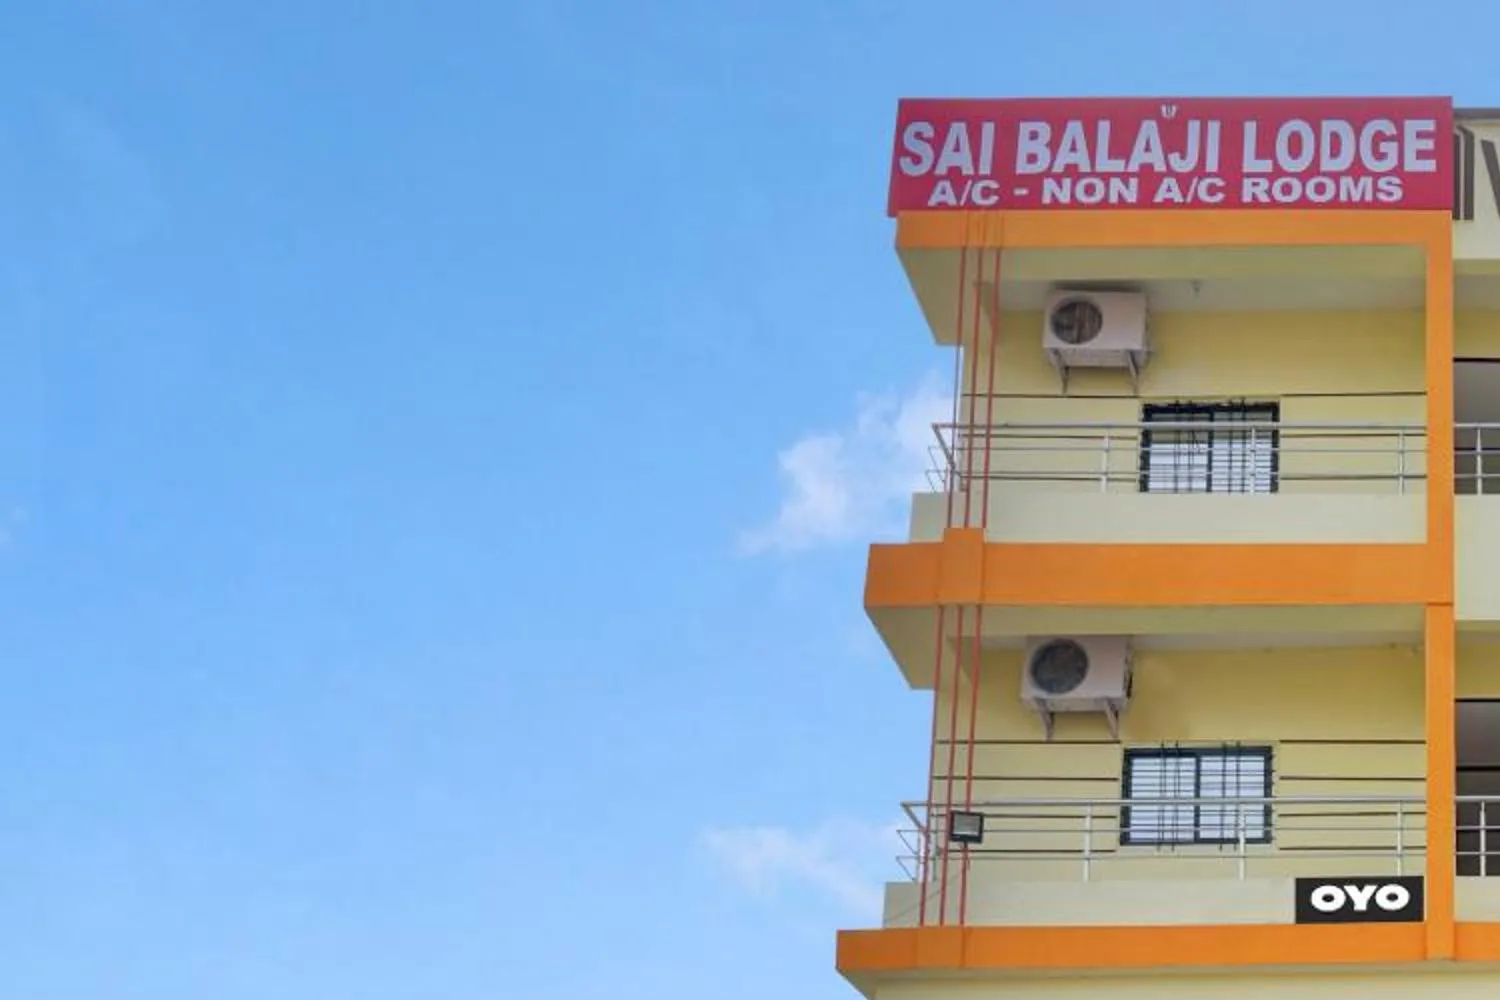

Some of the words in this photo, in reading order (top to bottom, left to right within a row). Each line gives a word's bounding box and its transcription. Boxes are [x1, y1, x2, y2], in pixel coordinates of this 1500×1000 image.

[899, 120, 994, 175] SAI
[1015, 118, 1221, 174] BALAJI
[1243, 119, 1437, 173] LODGE
[927, 179, 999, 207] A/C
[1041, 177, 1139, 204] NON
[1152, 176, 1224, 204] A/C
[1241, 175, 1403, 203] ROOMS
[1311, 884, 1410, 912] OYO
